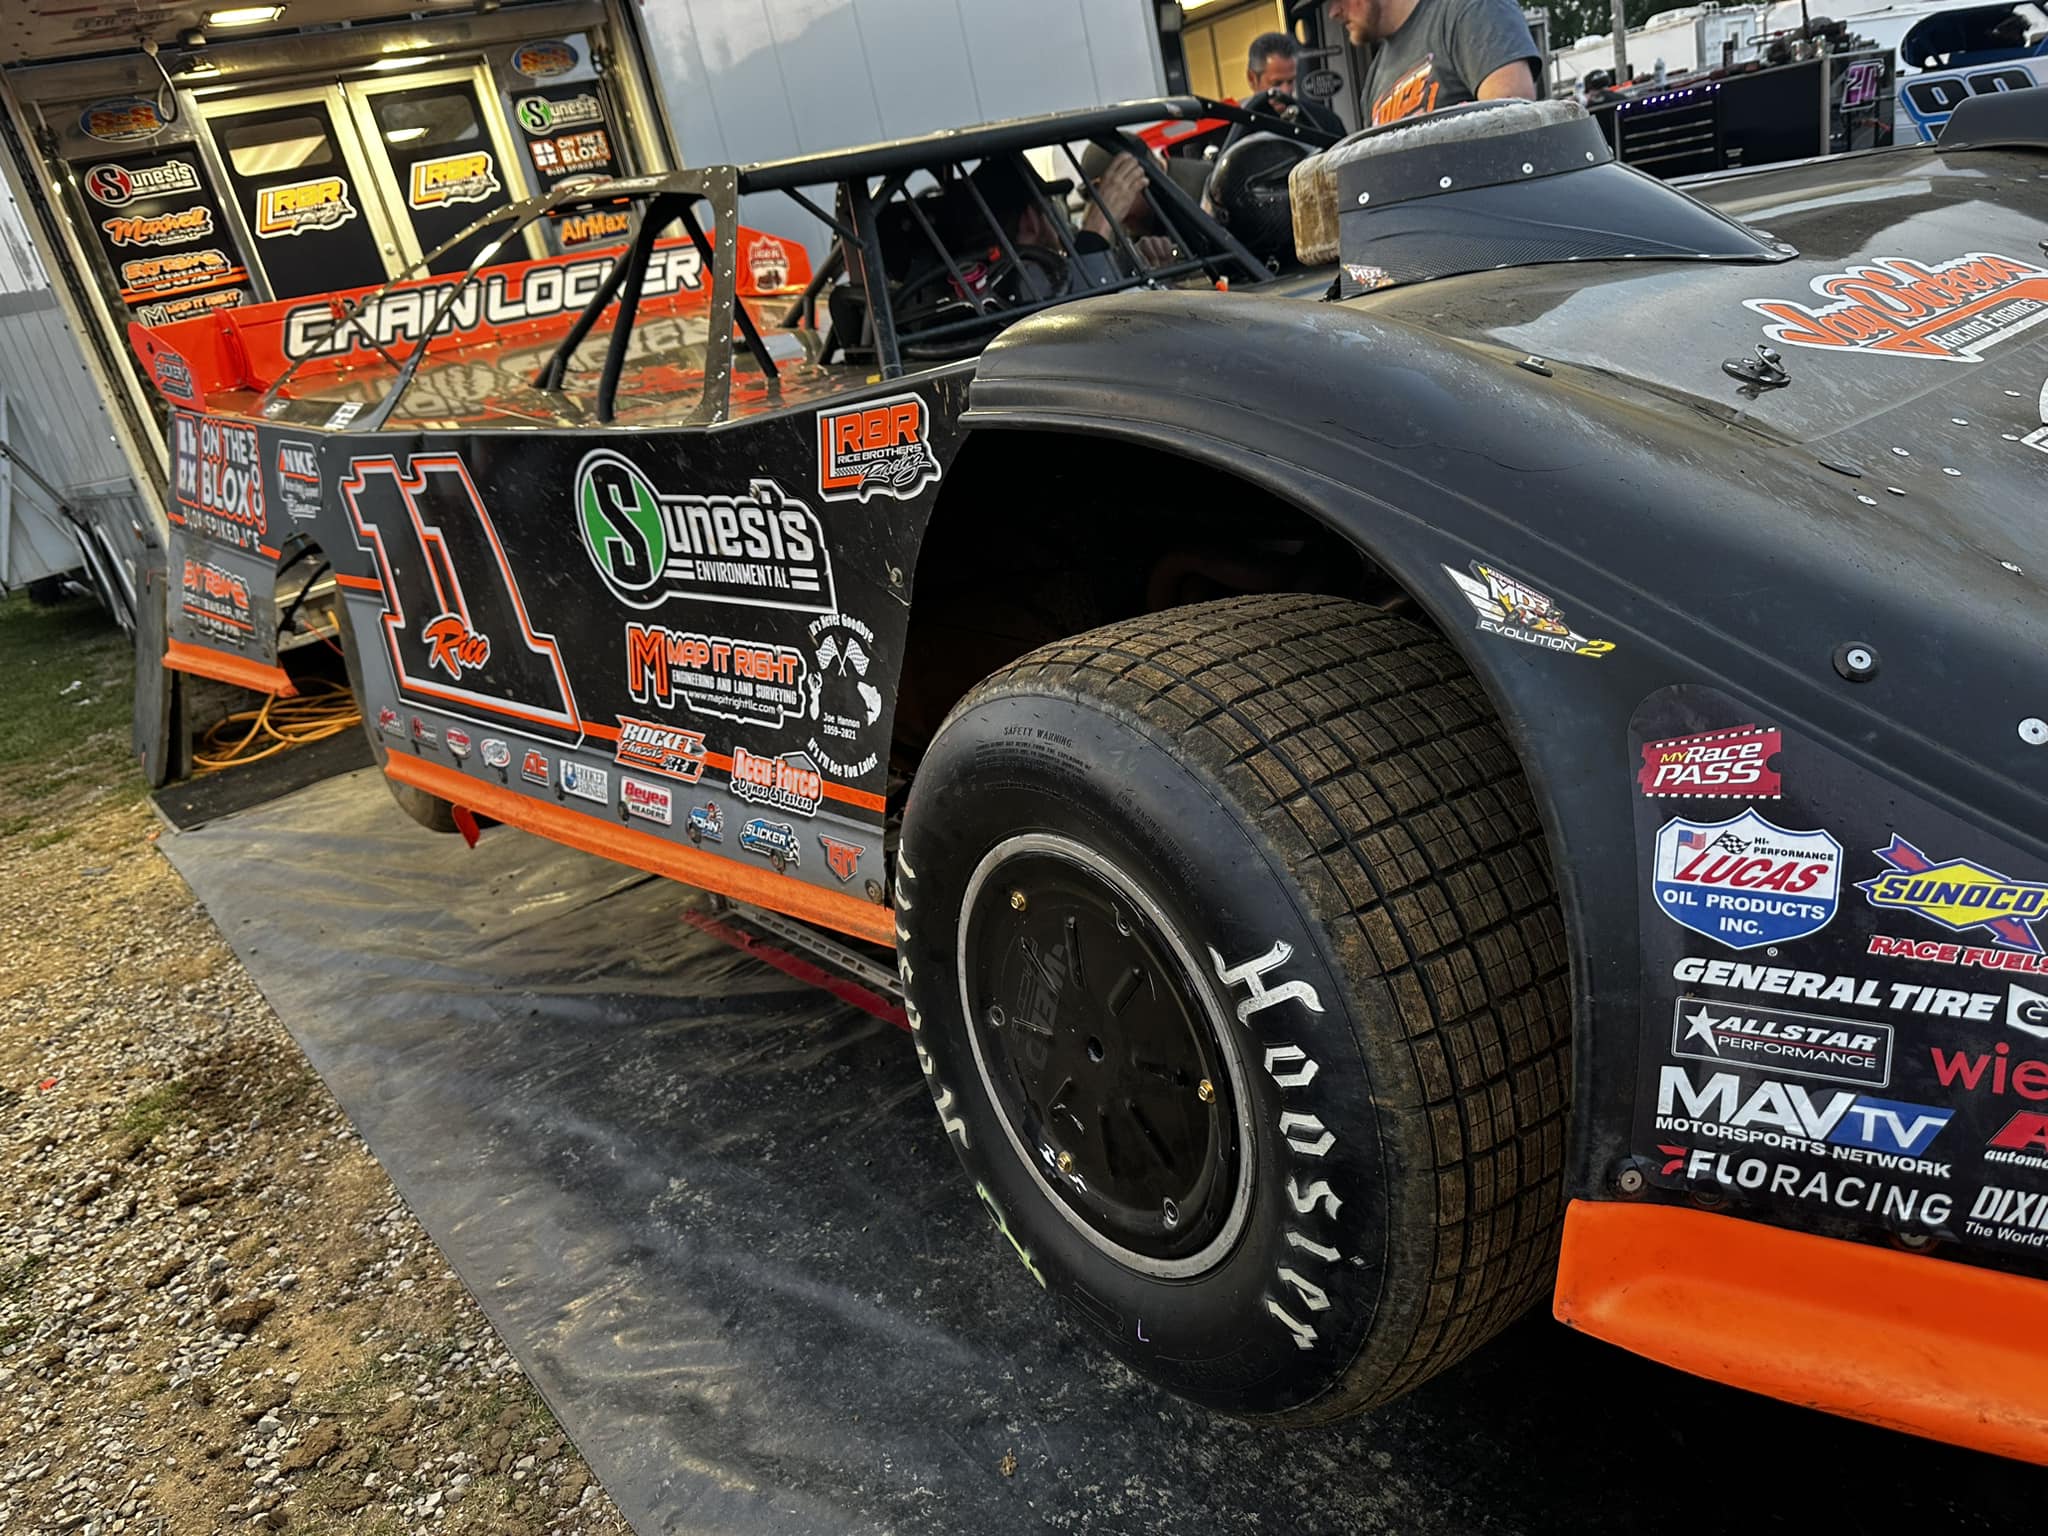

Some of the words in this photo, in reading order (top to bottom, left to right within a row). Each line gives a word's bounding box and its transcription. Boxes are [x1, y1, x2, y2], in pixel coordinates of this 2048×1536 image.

[96, 163, 192, 201] Sunesis
[561, 214, 629, 242] AirMax
[286, 280, 479, 357] CHAIN
[201, 422, 220, 458] ON
[222, 426, 249, 465] THE
[835, 402, 919, 455] RBR
[837, 453, 861, 464] RICE
[862, 443, 922, 461] BROTHERS
[857, 452, 932, 491] Racing
[202, 458, 251, 519] BLOX
[588, 462, 815, 587] Sunesis
[696, 560, 791, 590] ENVIRONMENTAL
[338, 453, 584, 749] 11
[808, 619, 822, 636] It's
[820, 614, 841, 631] Never
[841, 613, 874, 644] Goodbye
[1480, 619, 1578, 653] EVOLUTION
[1575, 638, 1617, 659] 2
[666, 636, 709, 667] MAP
[712, 644, 731, 674] IT
[733, 649, 799, 686] RIGHT
[671, 669, 715, 690] ENGINEERING
[716, 677, 732, 693] AND
[733, 679, 754, 697] LAND
[755, 684, 797, 706] SURVEYING
[822, 712, 836, 724] Joe
[1003, 726, 1033, 738] SAFETY
[620, 739, 664, 759] Chassis
[622, 722, 699, 755] ROCKET
[808, 736, 819, 757] It's
[829, 761, 843, 778] See
[843, 764, 859, 779] You
[858, 752, 879, 775] Later
[1652, 759, 1763, 788] PASS
[624, 780, 669, 808] Beyea
[779, 788, 813, 811] Testers
[631, 803, 666, 820] HEADERS
[745, 823, 787, 846] SLICKER
[1753, 837, 1770, 846] HI-
[1753, 846, 1834, 862] PERFORMANCE
[1675, 852, 1829, 893] LUCAS
[1662, 887, 1698, 907] OIL
[1705, 893, 1825, 921] PRODUCTS
[1878, 876, 2048, 914] SUNOCO
[1719, 916, 1764, 937] INC.
[1867, 934, 1959, 964] RACE
[1673, 957, 1882, 1007] GENERAL
[1889, 982, 2002, 1022] TIRE
[1715, 1014, 1882, 1052] ALLSTAR
[1717, 1035, 1877, 1068] PERFORMANCE
[1655, 1116, 1826, 1156] MOTORSPORTS
[1832, 1145, 1952, 1179] NETWORK
[1965, 1221, 1994, 1238] The
